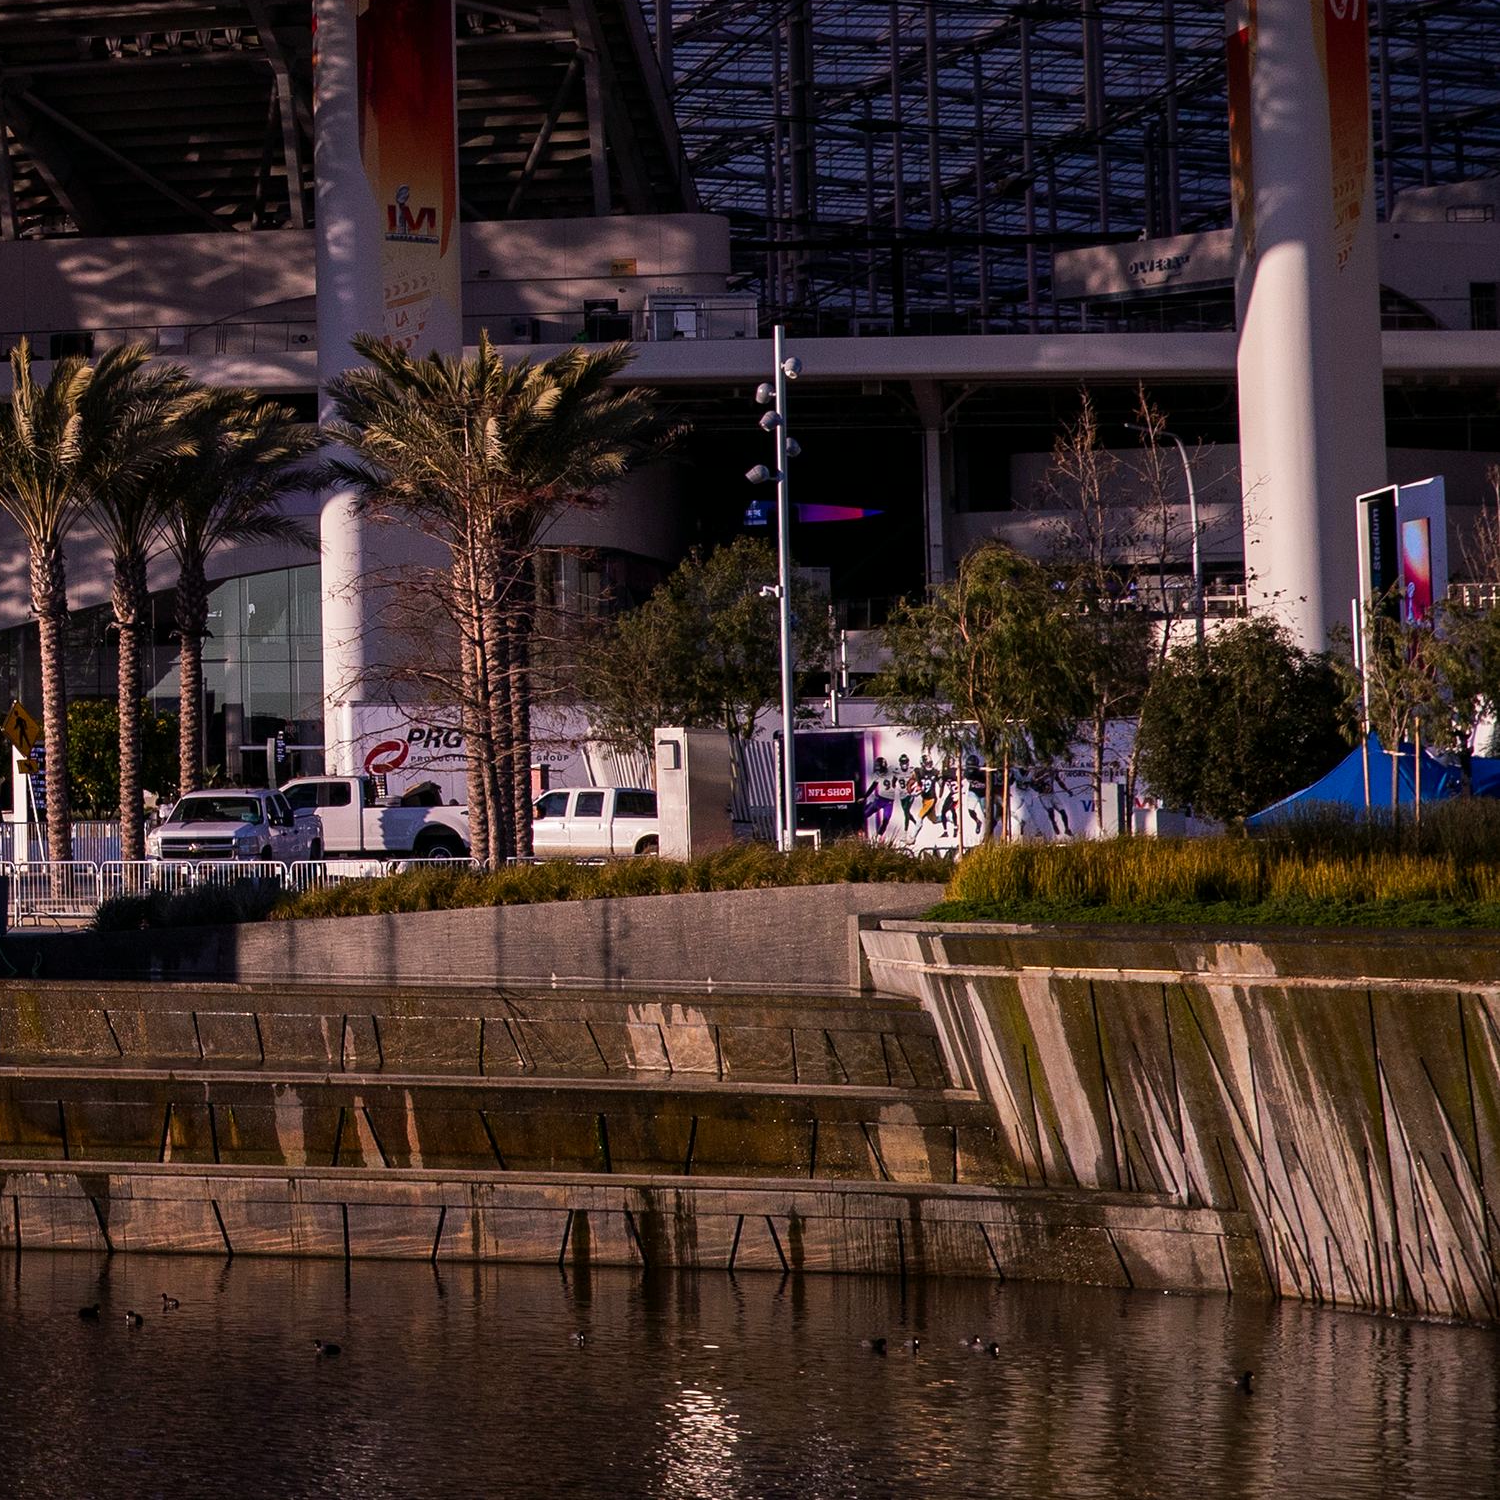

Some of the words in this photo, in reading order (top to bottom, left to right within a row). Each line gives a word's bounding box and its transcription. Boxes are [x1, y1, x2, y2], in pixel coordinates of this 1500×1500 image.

[407, 728, 463, 749] PRG
[807, 788, 826, 797] NFL
[827, 787, 852, 796] SHOP
